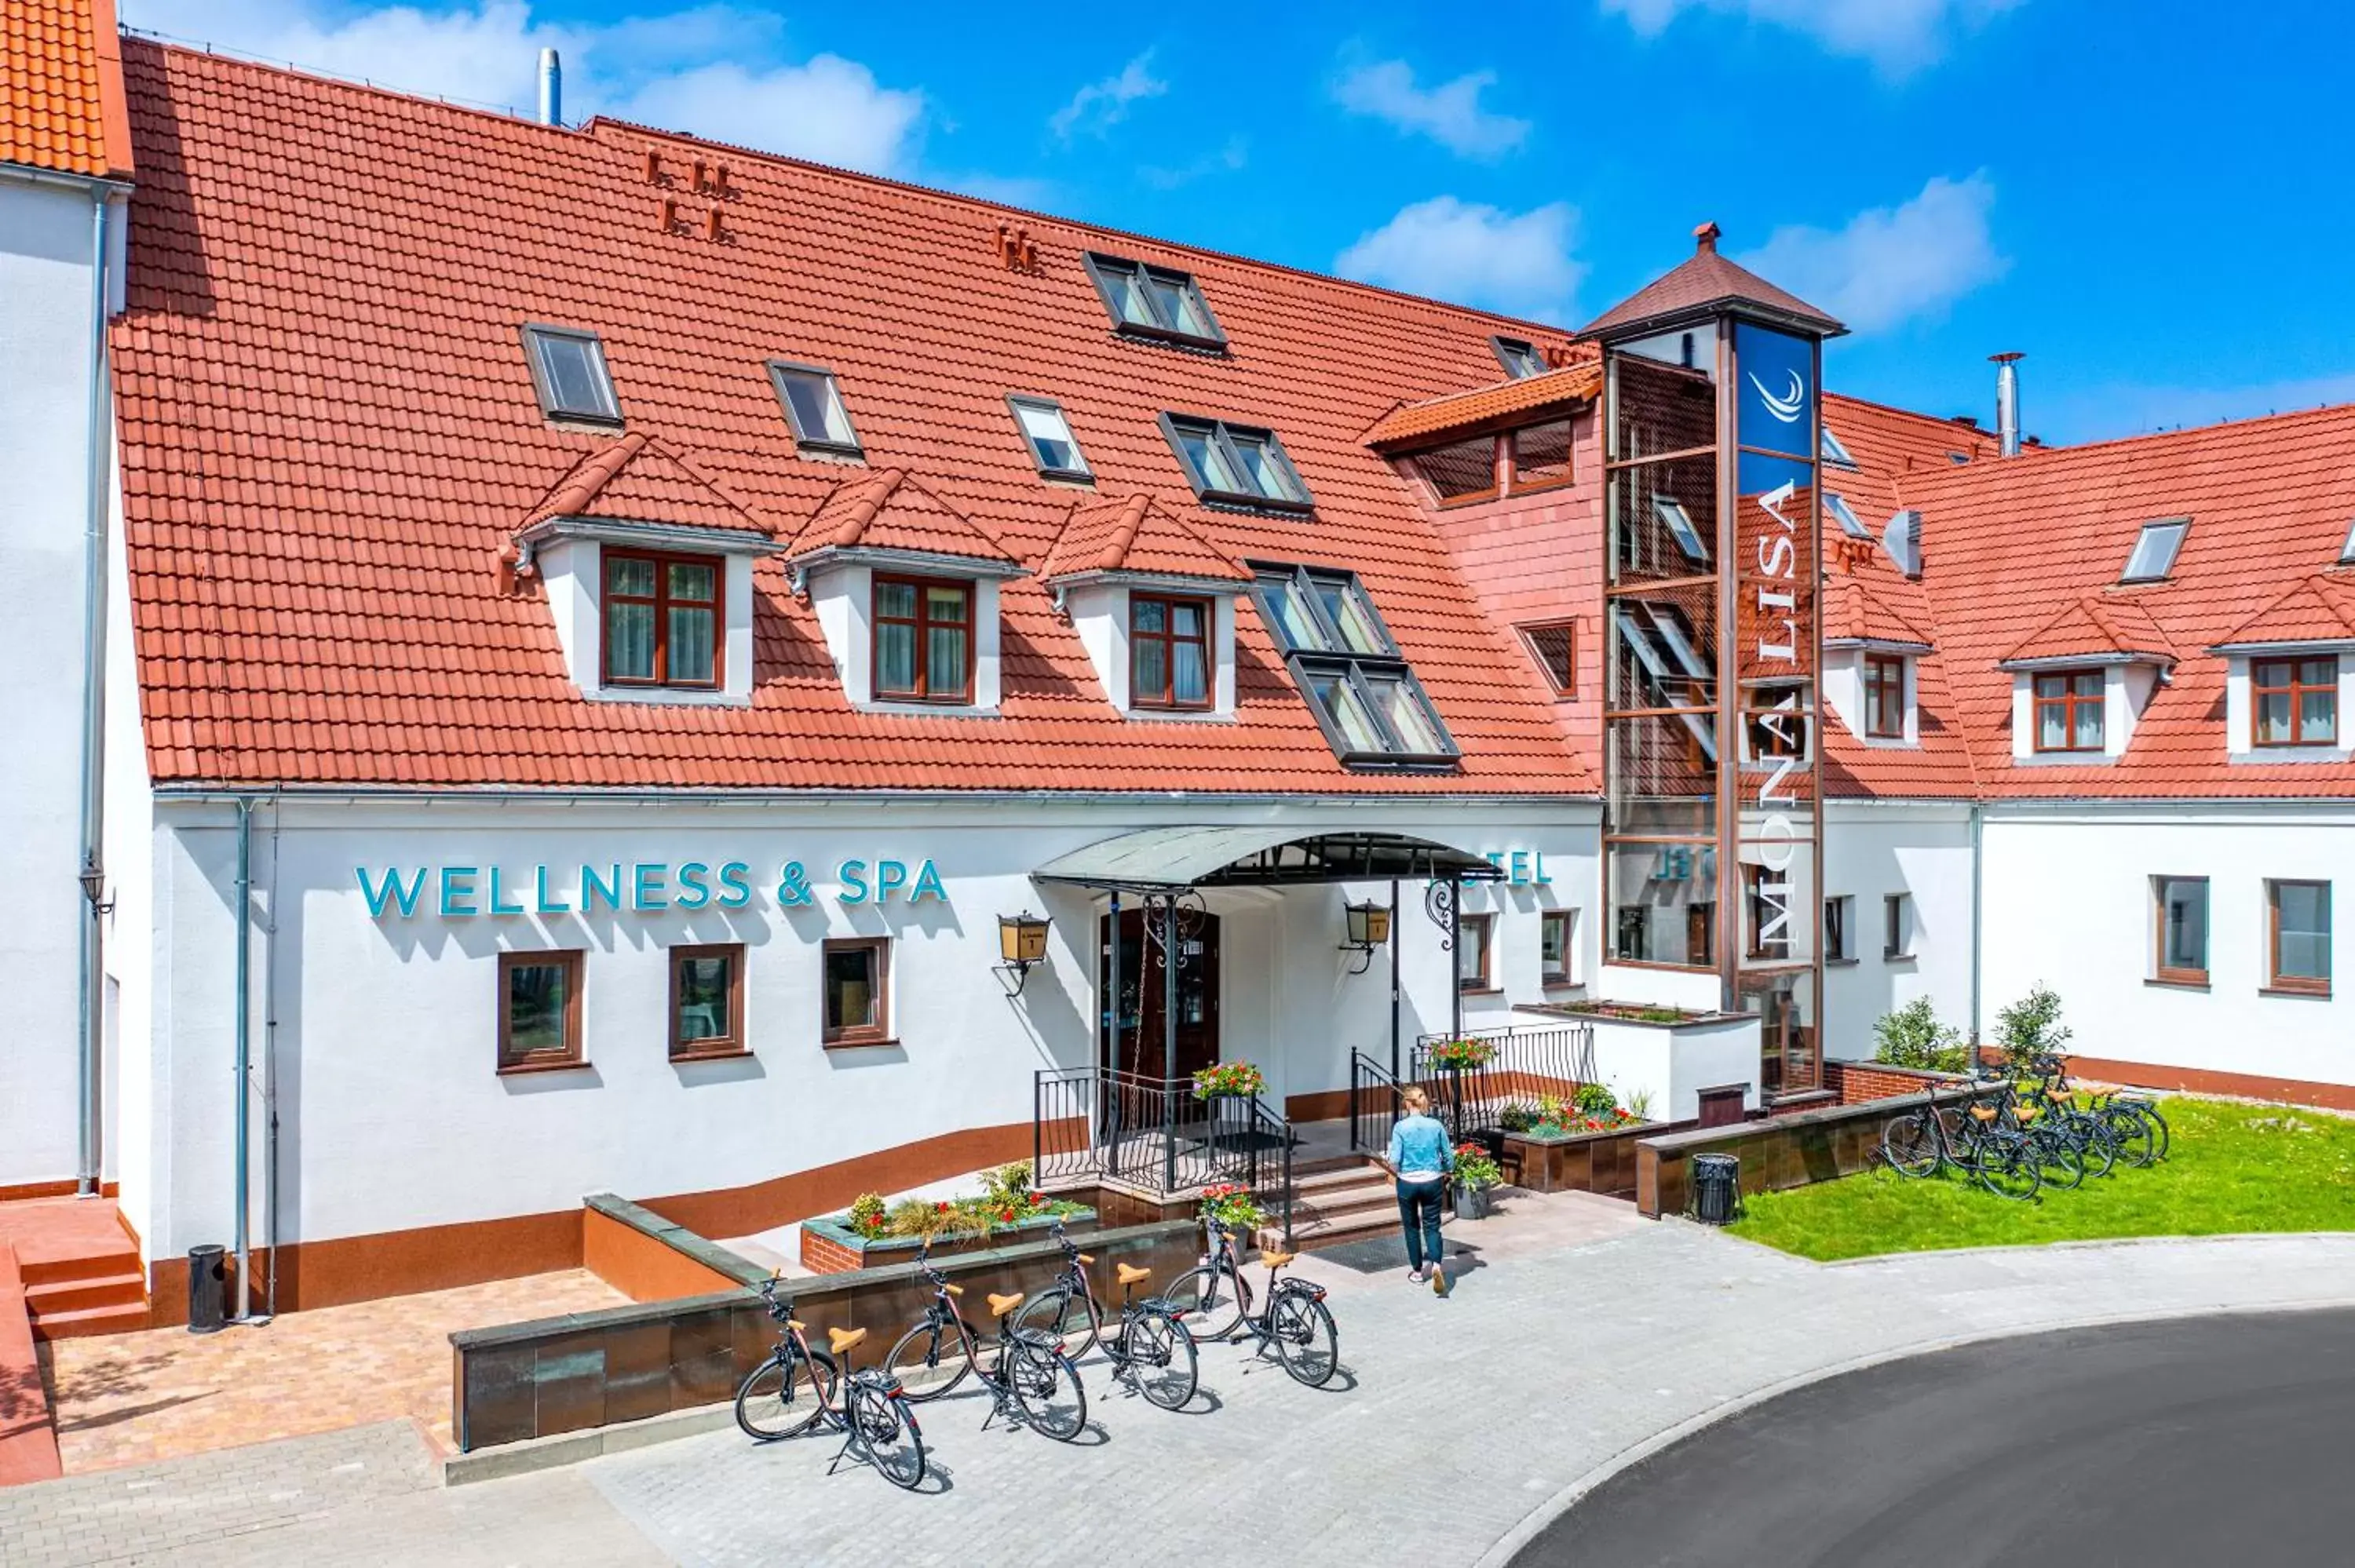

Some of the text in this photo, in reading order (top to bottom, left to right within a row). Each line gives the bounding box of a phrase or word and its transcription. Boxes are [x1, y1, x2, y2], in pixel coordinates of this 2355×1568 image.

[1758, 478, 1798, 950] MONA LISA
[356, 859, 948, 917] WELLNESS & SPA
